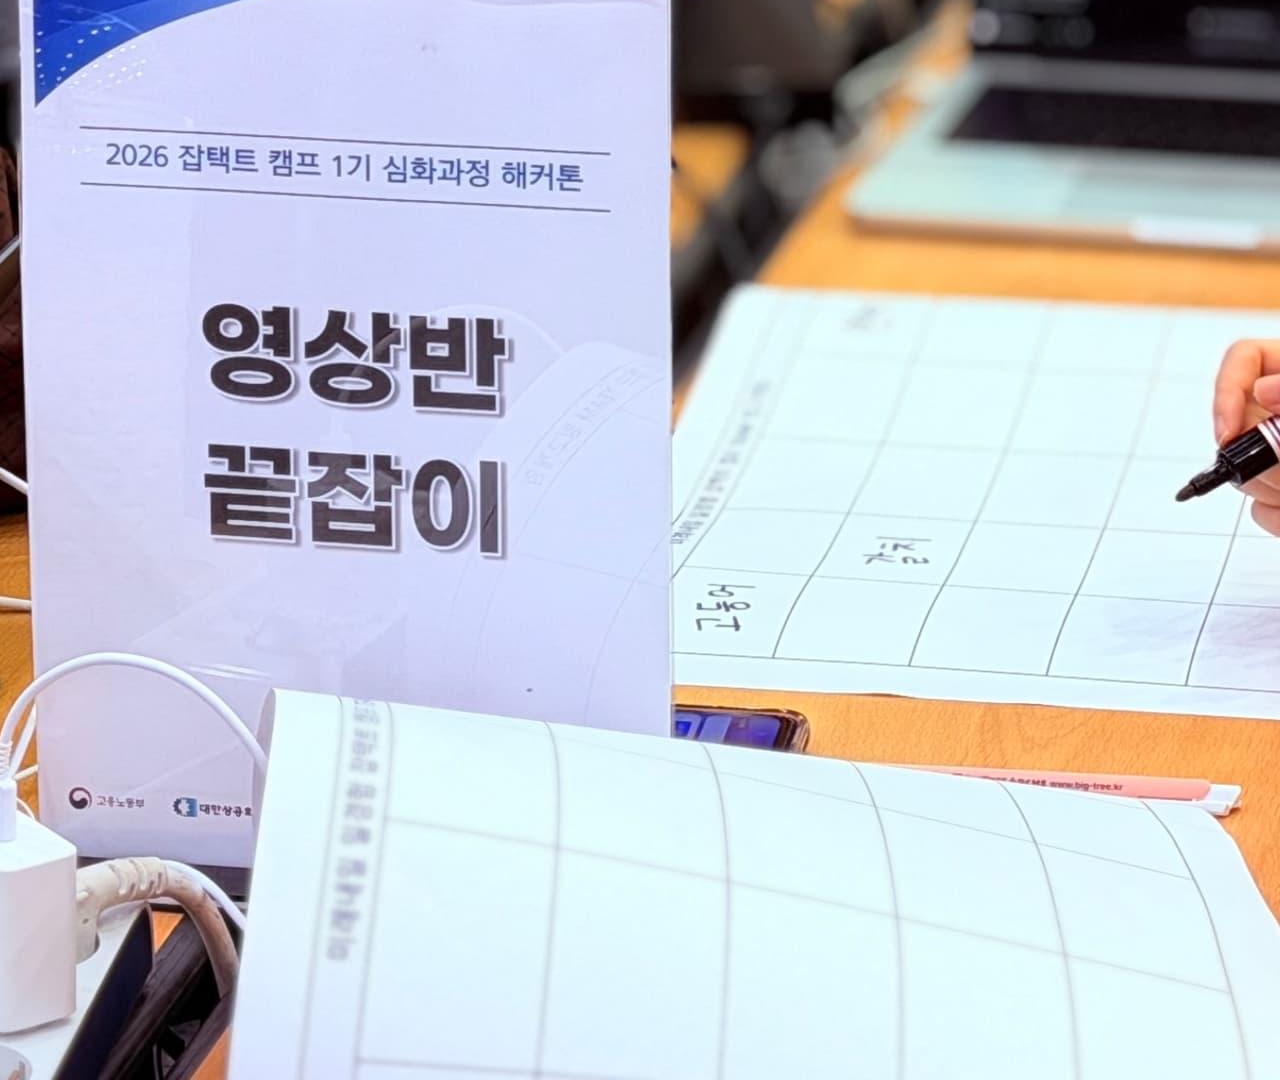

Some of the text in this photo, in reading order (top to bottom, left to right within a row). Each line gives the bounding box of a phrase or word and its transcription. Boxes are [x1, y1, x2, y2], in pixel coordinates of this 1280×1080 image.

[106, 143, 584, 192] 2026 잡택트 캠프 1기 심화과정 해커톤
[202, 302, 508, 411] 영상반
[204, 443, 503, 554] 끝잡이
[863, 536, 931, 566] 갈치
[695, 583, 756, 632] 고등어
[96, 796, 145, 809] 고용노동부
